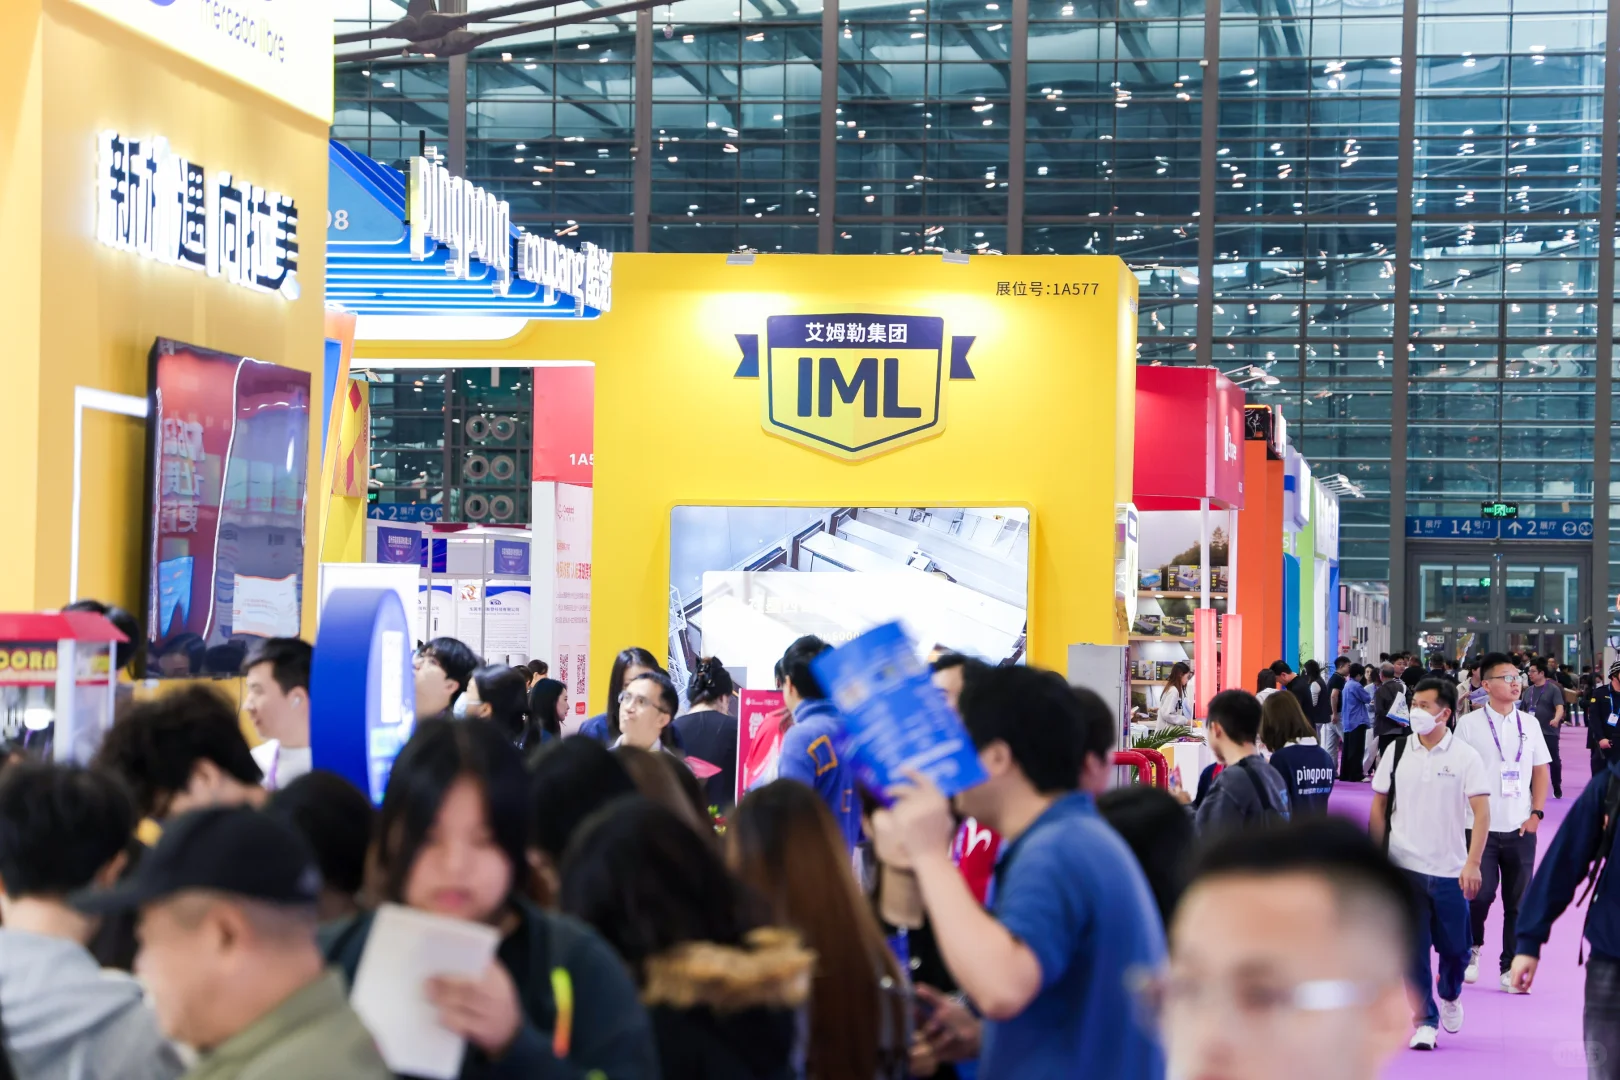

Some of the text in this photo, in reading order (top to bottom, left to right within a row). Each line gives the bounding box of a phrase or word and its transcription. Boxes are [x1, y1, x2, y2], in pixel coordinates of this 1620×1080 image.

[410, 146, 510, 298] pingpong
[518, 232, 585, 317] coupang
[995, 281, 1100, 296] 展位号:1A577
[804, 322, 908, 344] 艾姆勒集团
[797, 357, 922, 418] IML
[388, 505, 398, 521] 2
[1413, 519, 1491, 534] 1 展厅 14 号门
[1526, 521, 1557, 535] 2 展厅
